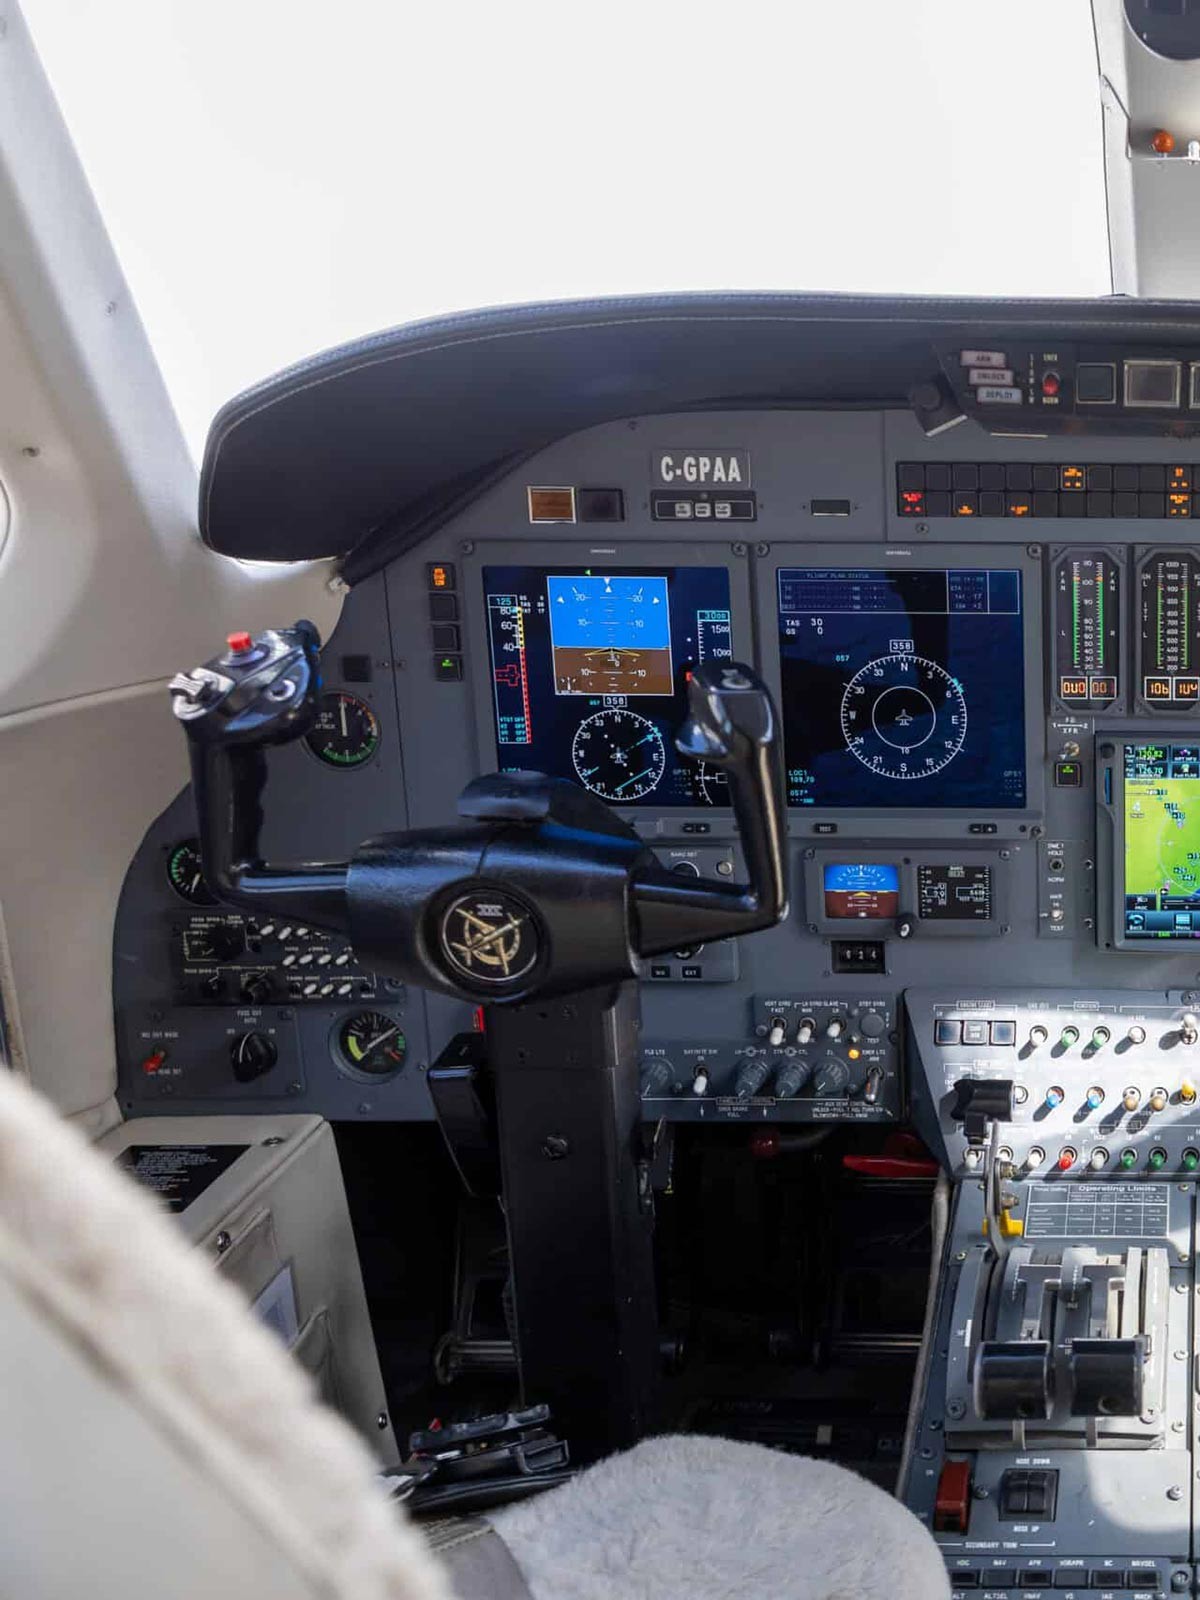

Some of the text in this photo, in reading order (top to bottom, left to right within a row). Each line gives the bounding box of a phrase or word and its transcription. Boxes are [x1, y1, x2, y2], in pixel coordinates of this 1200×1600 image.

[661, 456, 742, 482] C-GPAA
[496, 597, 512, 606] 125
[632, 594, 643, 602] 20
[501, 621, 512, 630] 60
[578, 618, 587, 627] 10
[634, 619, 644, 628] 10
[811, 618, 824, 626] 30
[503, 643, 515, 651] 40
[892, 641, 911, 650] 358
[900, 662, 909, 672] N
[581, 668, 590, 677] 10
[637, 669, 647, 677] 10
[874, 668, 884, 677] 33
[606, 697, 624, 705] 358
[854, 736, 864, 744] 24
[873, 755, 883, 764] 21
[926, 757, 934, 766] 15
[965, 1541, 1018, 1549] SECONDARY TRIM
